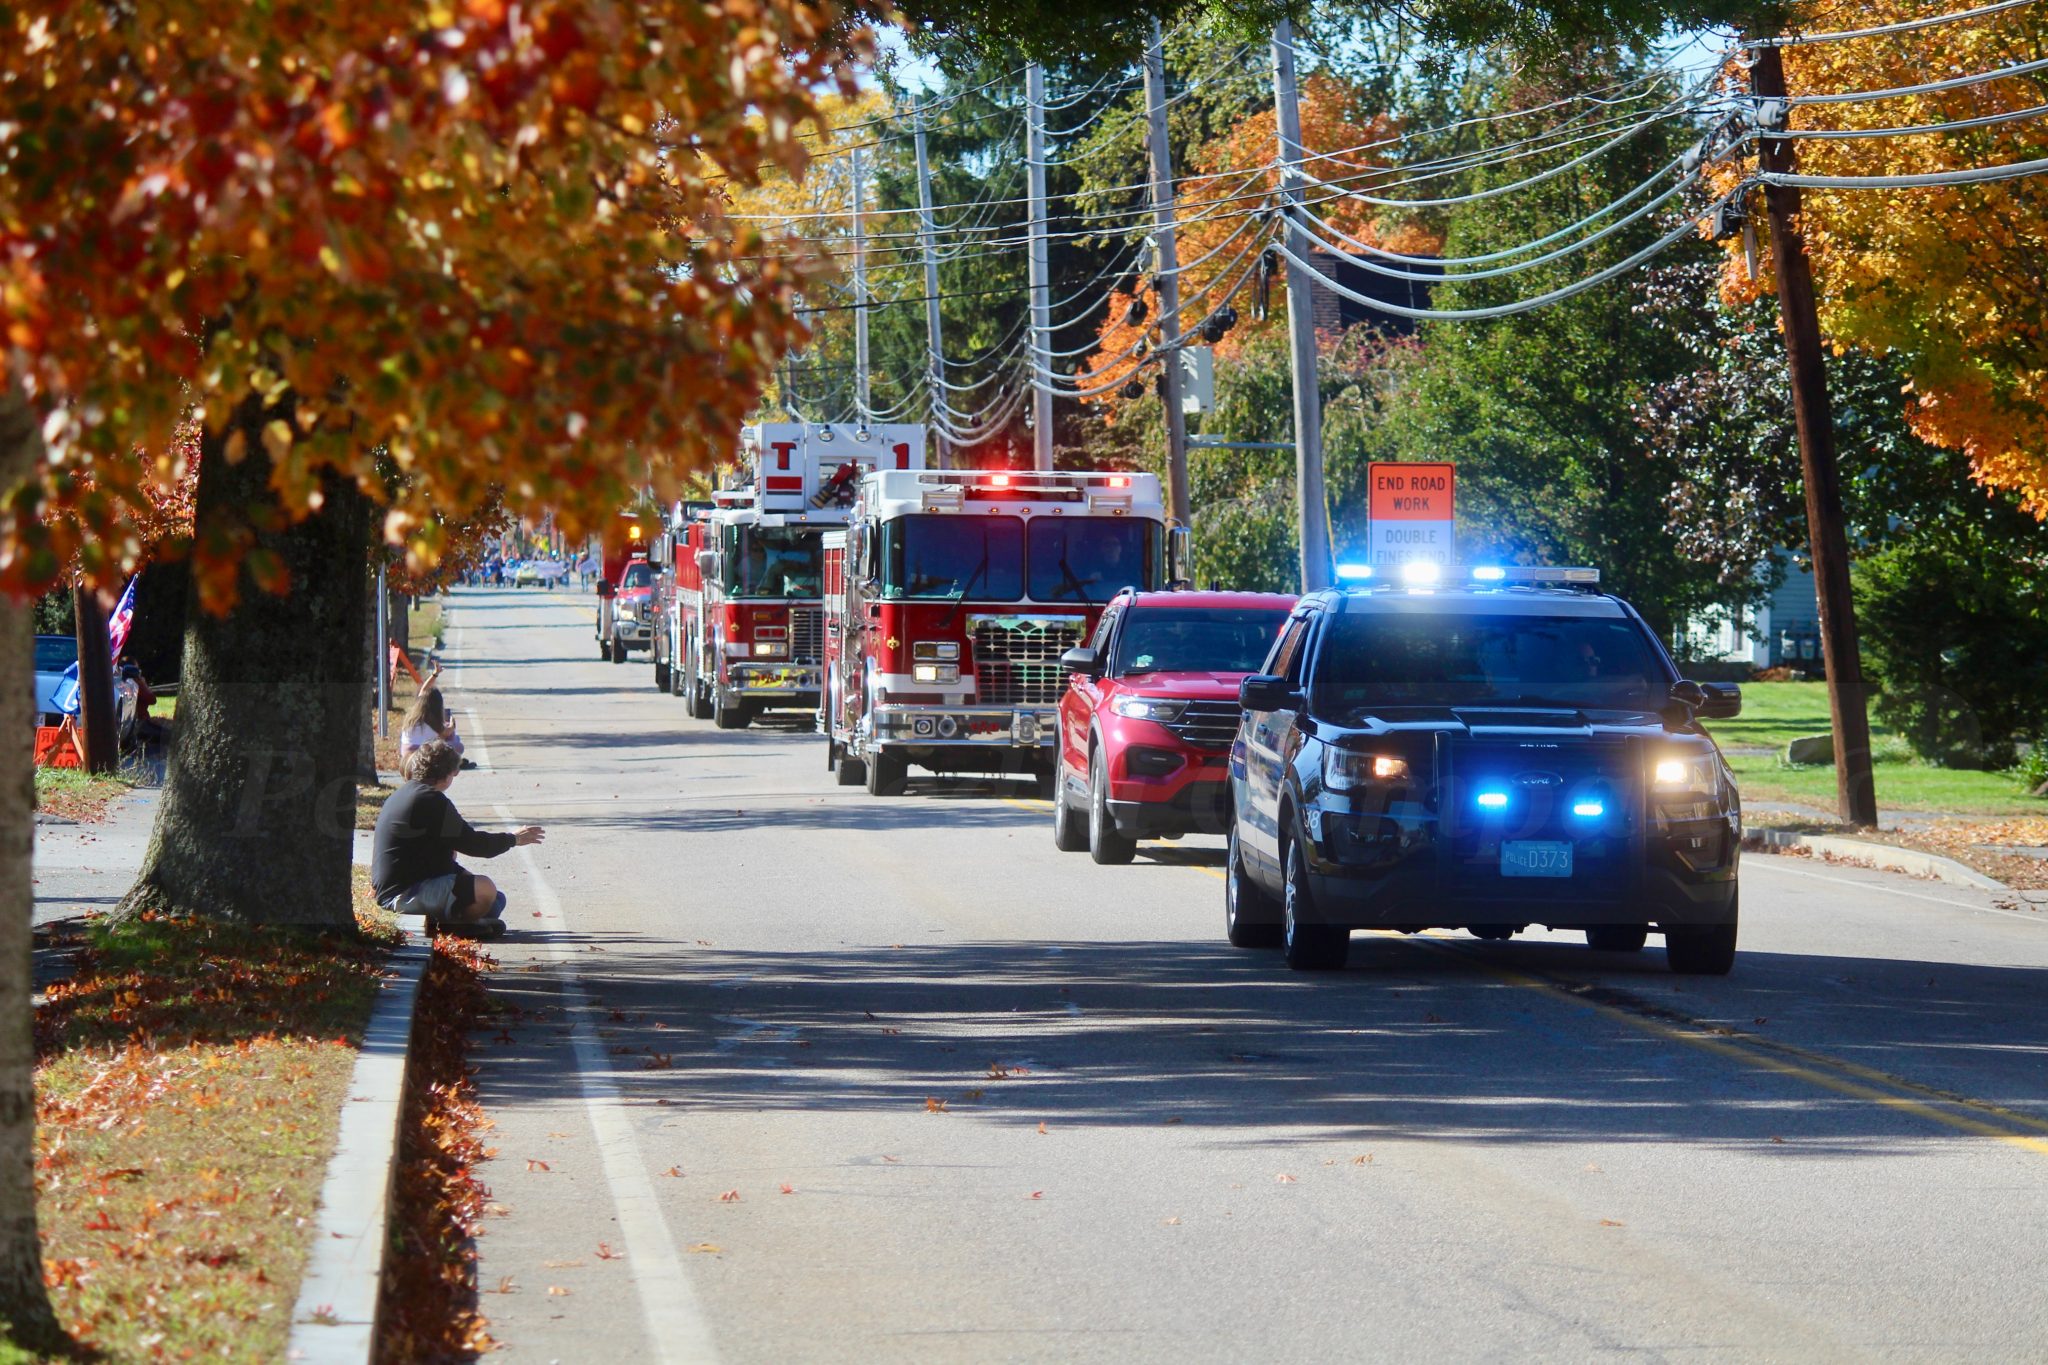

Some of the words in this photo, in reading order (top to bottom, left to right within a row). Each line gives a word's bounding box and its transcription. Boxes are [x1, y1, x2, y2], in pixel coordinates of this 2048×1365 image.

[770, 441, 797, 471] T
[892, 442, 910, 470] 1
[1378, 476, 1404, 491] END
[1411, 476, 1445, 491] ROAD
[1393, 497, 1430, 511] WORK
[1385, 530, 1437, 544] DOUBLE
[1529, 850, 1568, 868] D373
